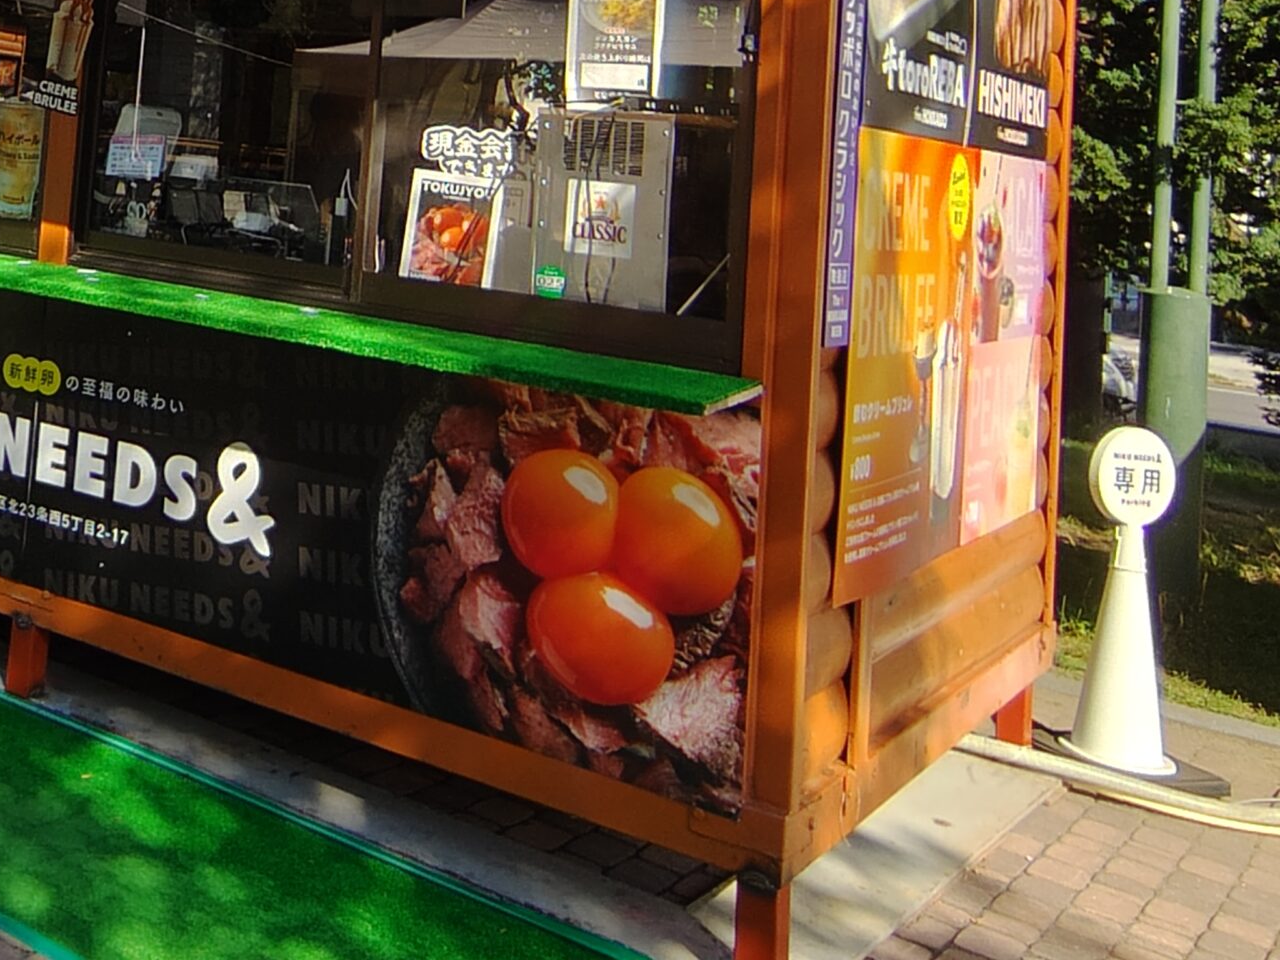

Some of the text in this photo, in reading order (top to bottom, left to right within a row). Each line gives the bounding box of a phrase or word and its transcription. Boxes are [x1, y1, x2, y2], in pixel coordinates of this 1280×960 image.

[33, 93, 79, 114] BRULEE
[38, 80, 78, 100] CREME
[977, 68, 1047, 129] HISHIMEKI
[7, 361, 56, 388] 新鮮卵
[65, 374, 185, 415] の至福の味わい
[205, 442, 277, 559] &
[1113, 466, 1161, 495] 専用
